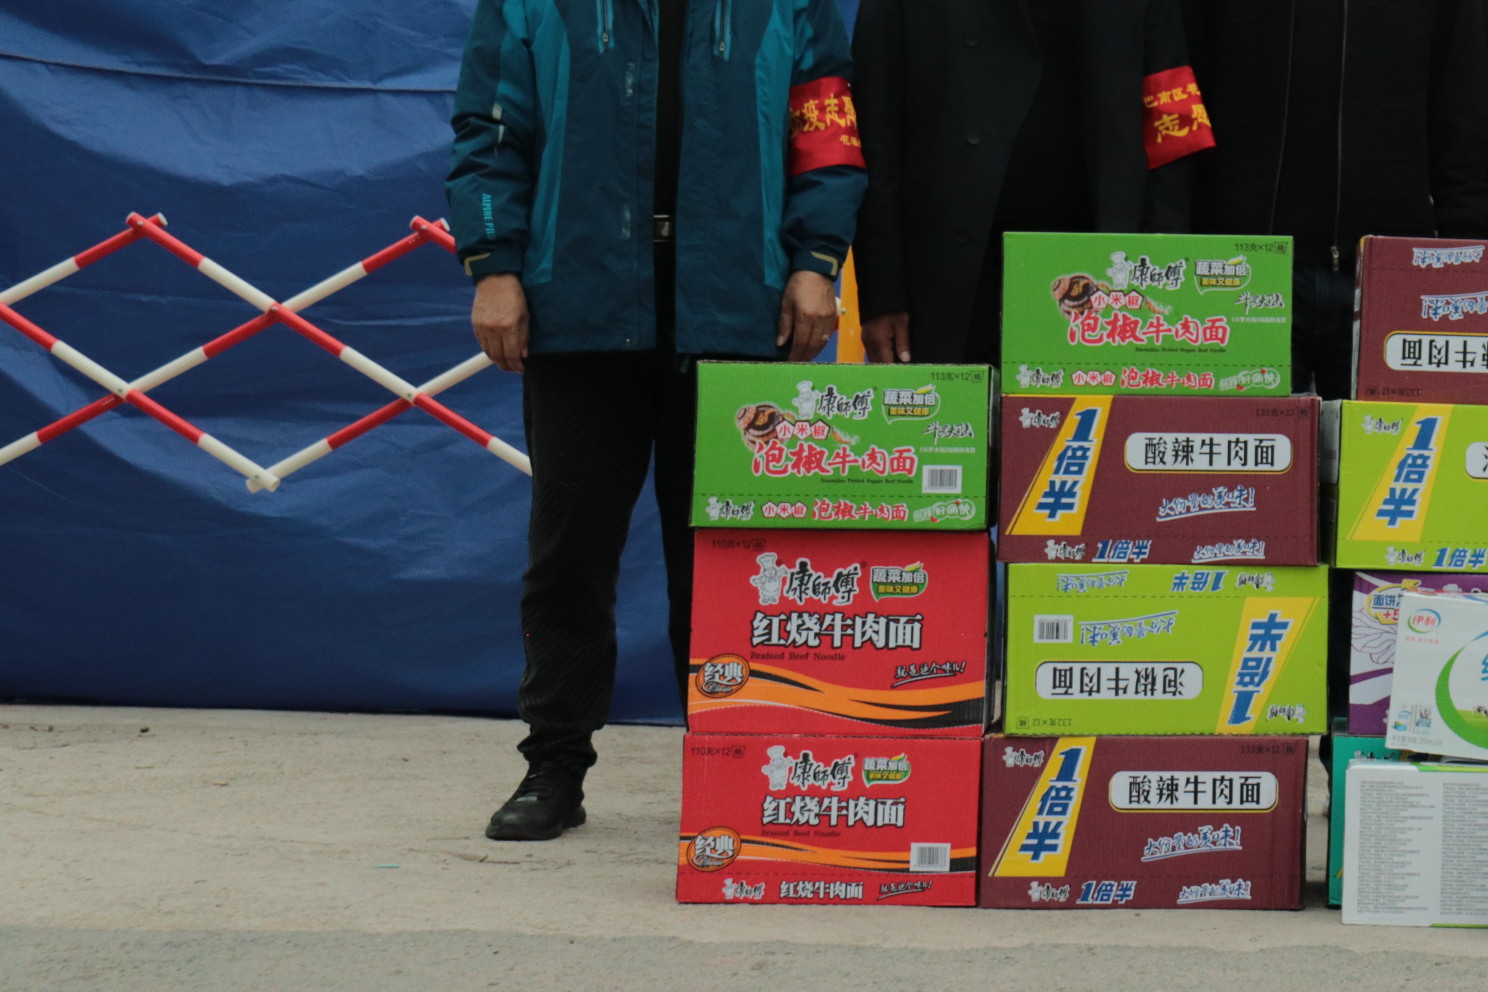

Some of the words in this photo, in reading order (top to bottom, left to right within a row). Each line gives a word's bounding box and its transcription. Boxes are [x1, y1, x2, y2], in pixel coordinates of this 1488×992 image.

[1195, 260, 1249, 276] 蔬菜加倍
[1093, 293, 1141, 307] 小米椒
[1068, 311, 1230, 345] 泡椒牛肉面
[1074, 371, 1115, 384] 小米椒
[1120, 368, 1214, 389] 泡椒牛肉面
[883, 390, 936, 405] 蔬菜加倍
[779, 423, 827, 437] 小米椒
[753, 441, 918, 476] 泡椒牛肉面
[1144, 437, 1276, 467] 酸辣牛肉面
[1034, 407, 1103, 521] 1倍半
[1375, 416, 1442, 528] 1倍半
[764, 503, 805, 516] 小米椒
[812, 500, 908, 521] 泡椒牛肉面
[1092, 540, 1151, 562] 1倍半
[872, 567, 925, 583] 蔬菜加倍
[1172, 571, 1228, 592] 1倍半
[1373, 594, 1404, 607] 面饼
[1383, 608, 1399, 621] +5
[1412, 614, 1436, 627] 伊利
[752, 612, 923, 648] 红烧牛肉面
[751, 651, 784, 661] Braised
[789, 651, 809, 661] Beef
[813, 651, 846, 661] Noodle
[704, 662, 744, 684] 经典
[1228, 610, 1294, 725] 1倍半
[1051, 666, 1186, 696] 泡椒牛肉面
[864, 758, 908, 771] 蔬菜加倍
[1128, 776, 1261, 805] 酸辣牛肉面
[762, 796, 906, 827] 红烧牛肉面
[1018, 746, 1086, 862] 1倍半
[793, 830, 810, 838] Beef
[814, 830, 841, 838] Noodle
[695, 835, 735, 857] 经典
[780, 882, 863, 899] 红烧牛肉面
[1076, 881, 1136, 903] 1倍半
